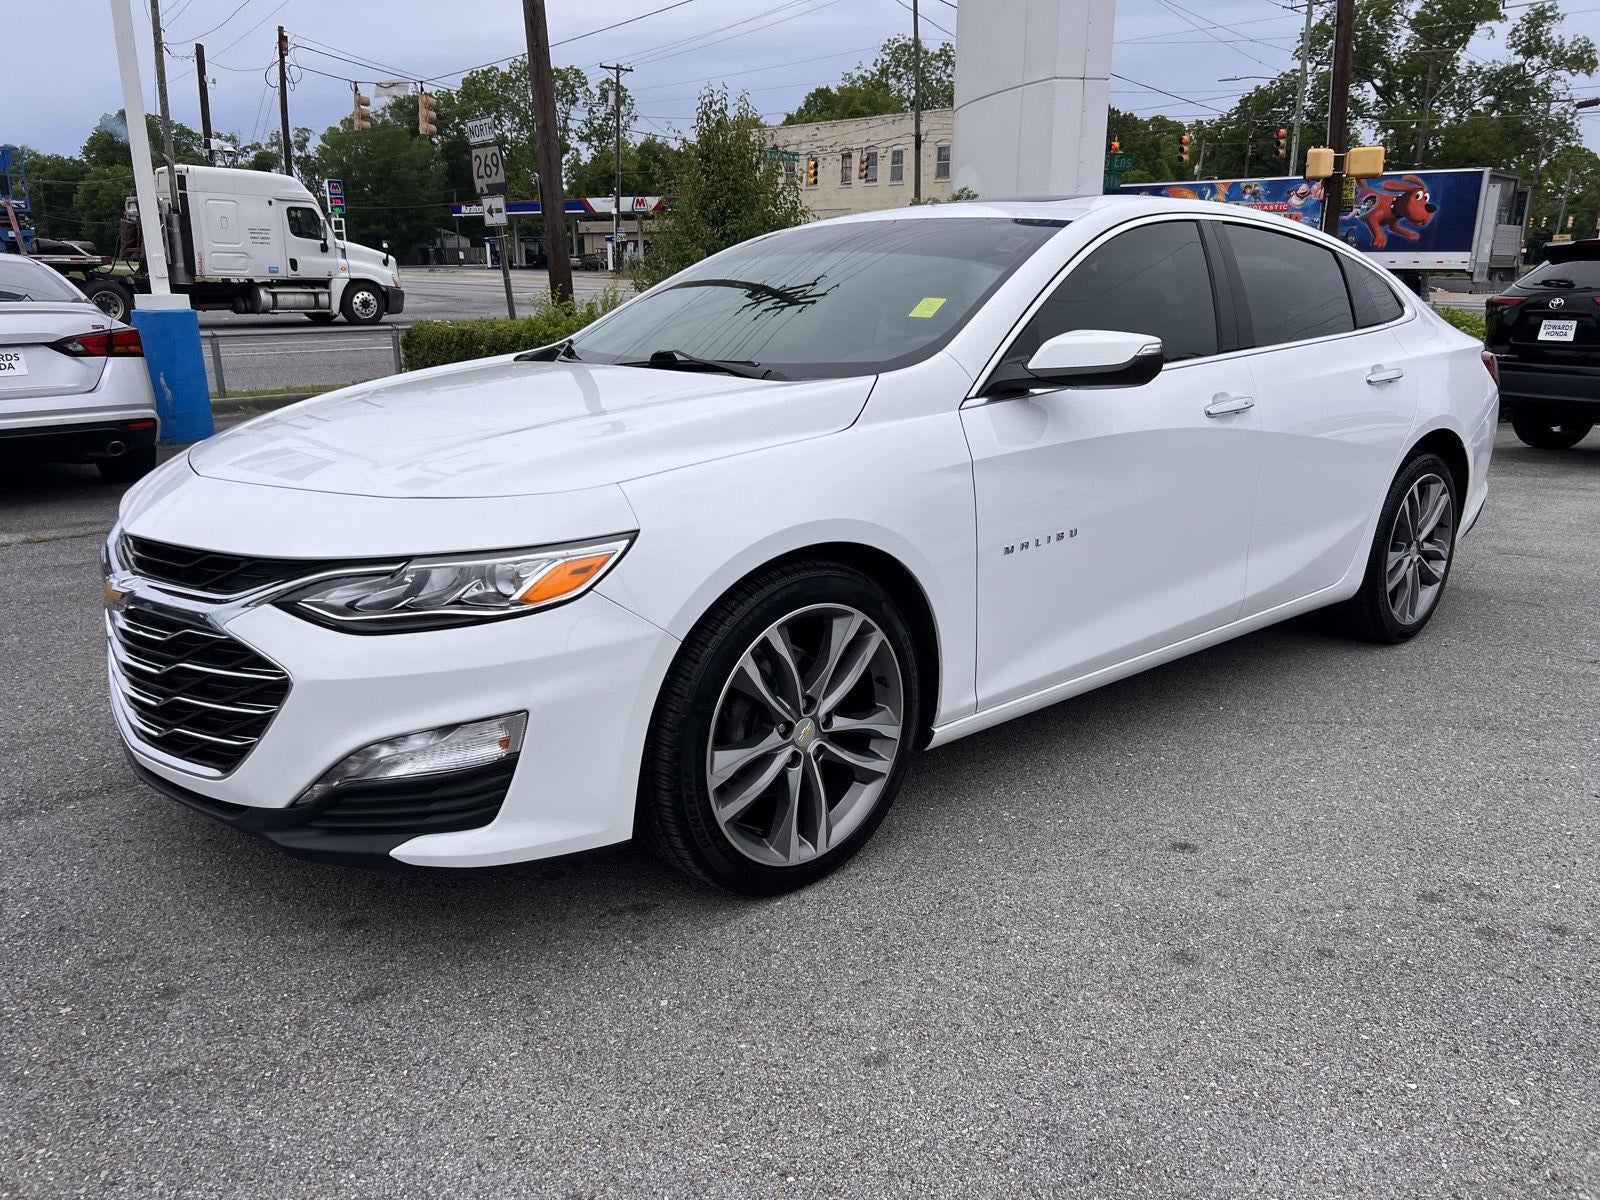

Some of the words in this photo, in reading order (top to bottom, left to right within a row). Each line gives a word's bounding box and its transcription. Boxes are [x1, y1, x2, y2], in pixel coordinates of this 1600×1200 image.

[469, 122, 494, 139] NORTH
[474, 152, 500, 179] 269
[461, 204, 484, 213] Marathon
[1003, 528, 1078, 556] MALIBU
